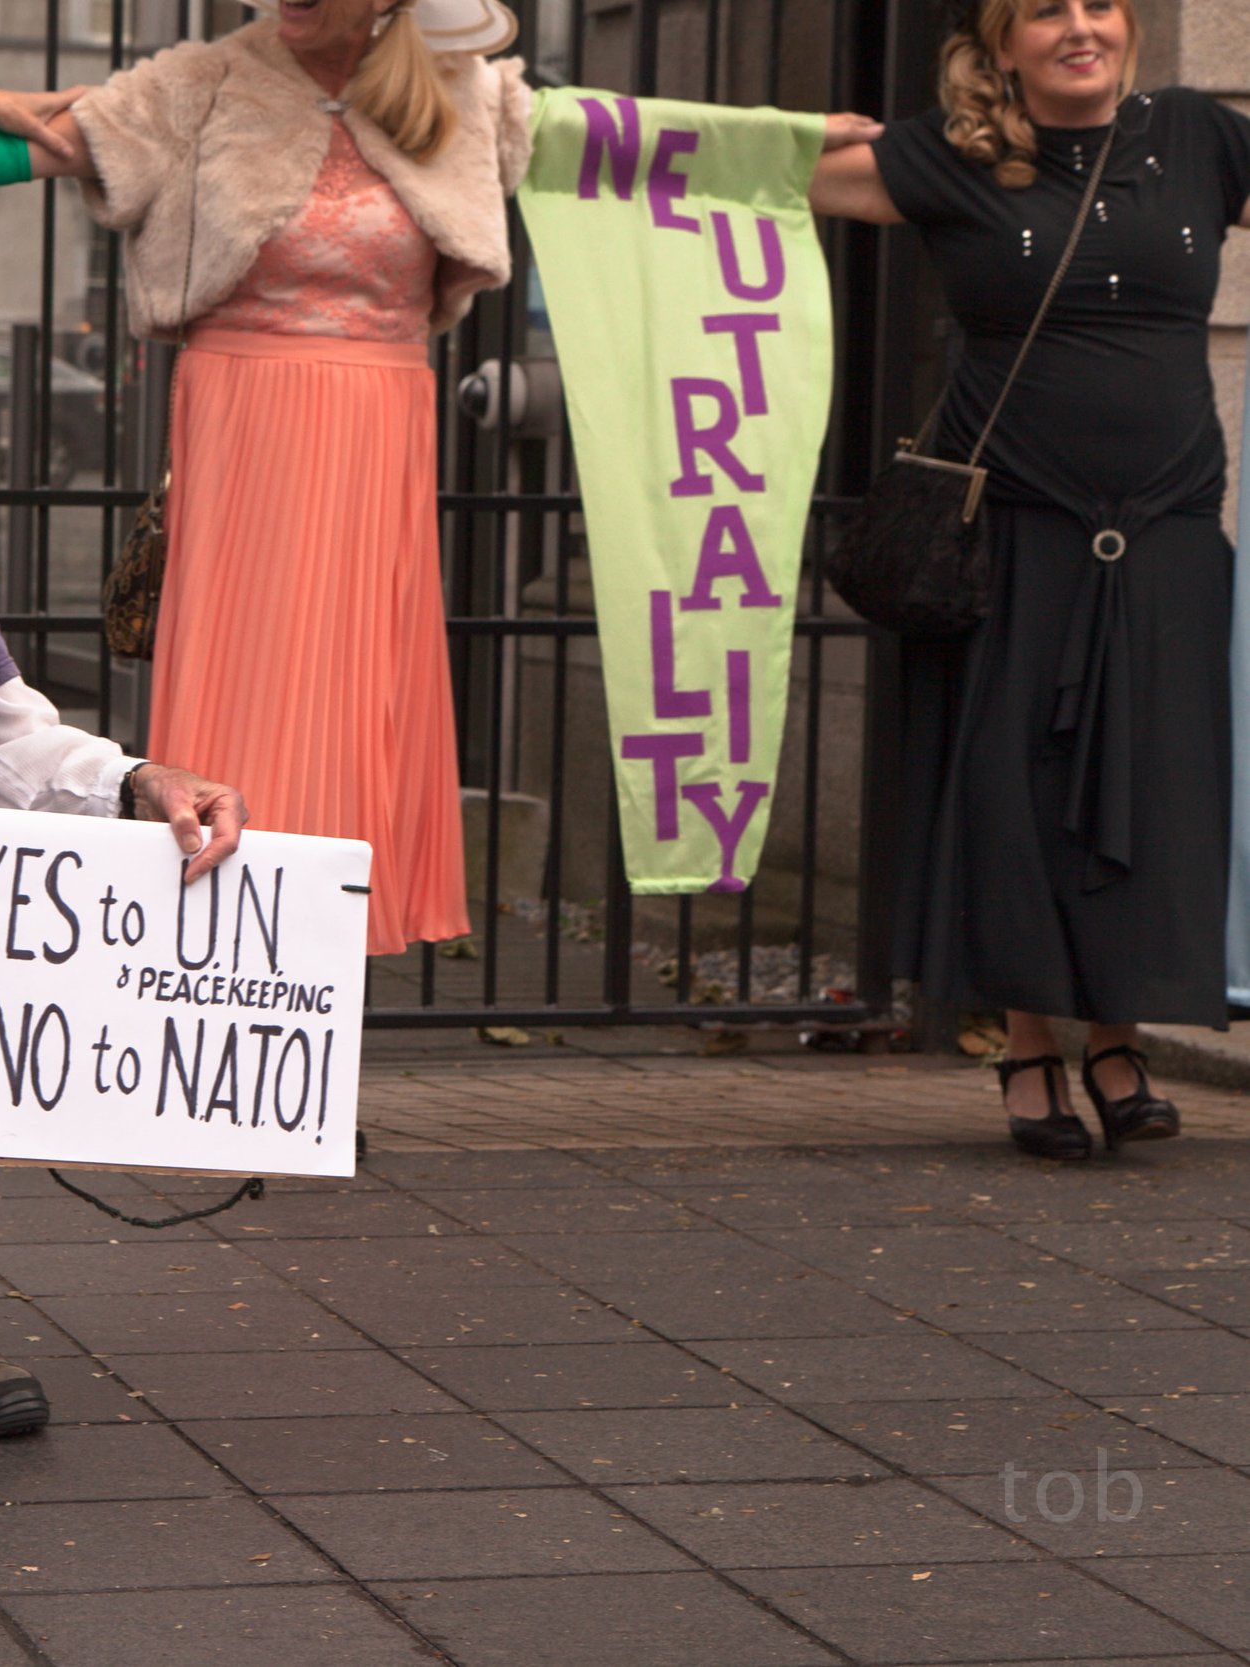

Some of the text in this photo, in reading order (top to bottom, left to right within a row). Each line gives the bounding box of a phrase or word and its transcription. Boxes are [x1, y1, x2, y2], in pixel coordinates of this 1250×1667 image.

[576, 95, 786, 893] NEUTRALITY
[98, 884, 146, 947] to
[137, 965, 335, 1015] PEACEKEEPING
[91, 1024, 142, 1095] to
